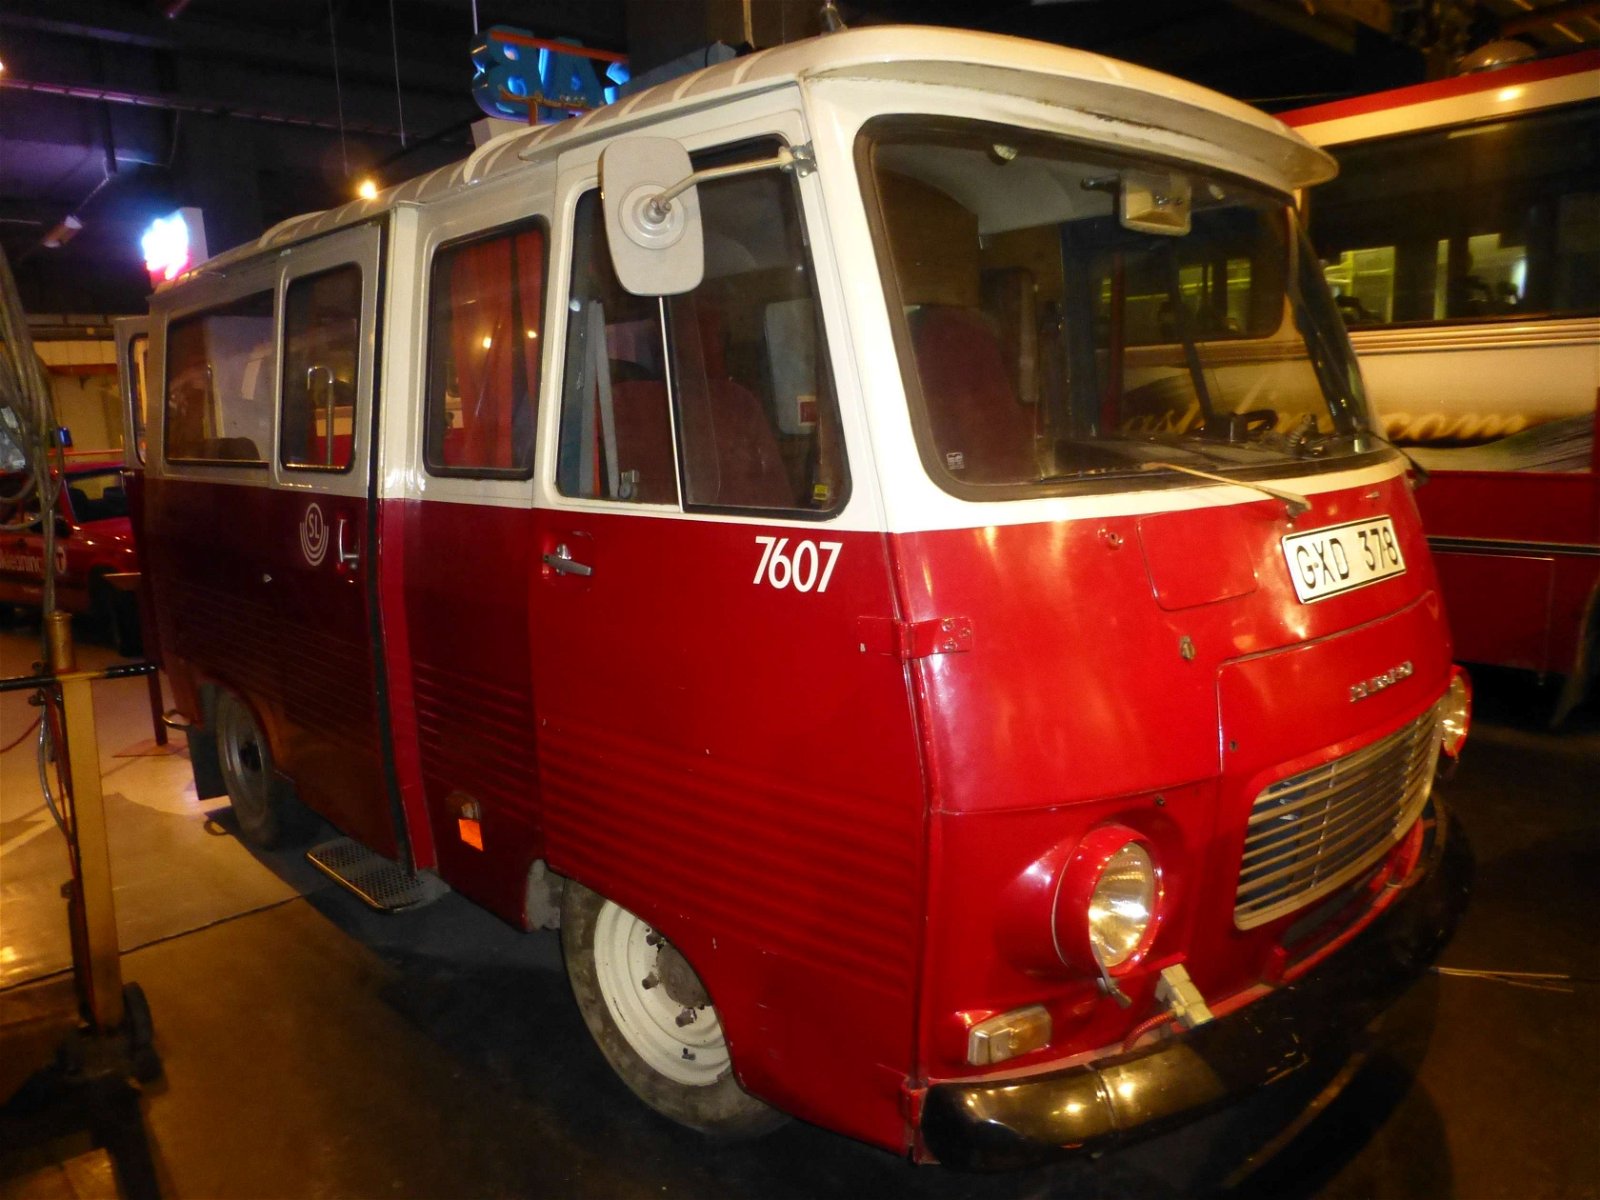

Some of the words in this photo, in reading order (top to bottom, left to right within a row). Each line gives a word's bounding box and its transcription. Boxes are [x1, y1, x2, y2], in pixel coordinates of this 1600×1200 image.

[308, 513, 319, 538] SL
[753, 535, 843, 593] 7607
[1296, 540, 1349, 589] GXD
[1358, 526, 1399, 571] 378
